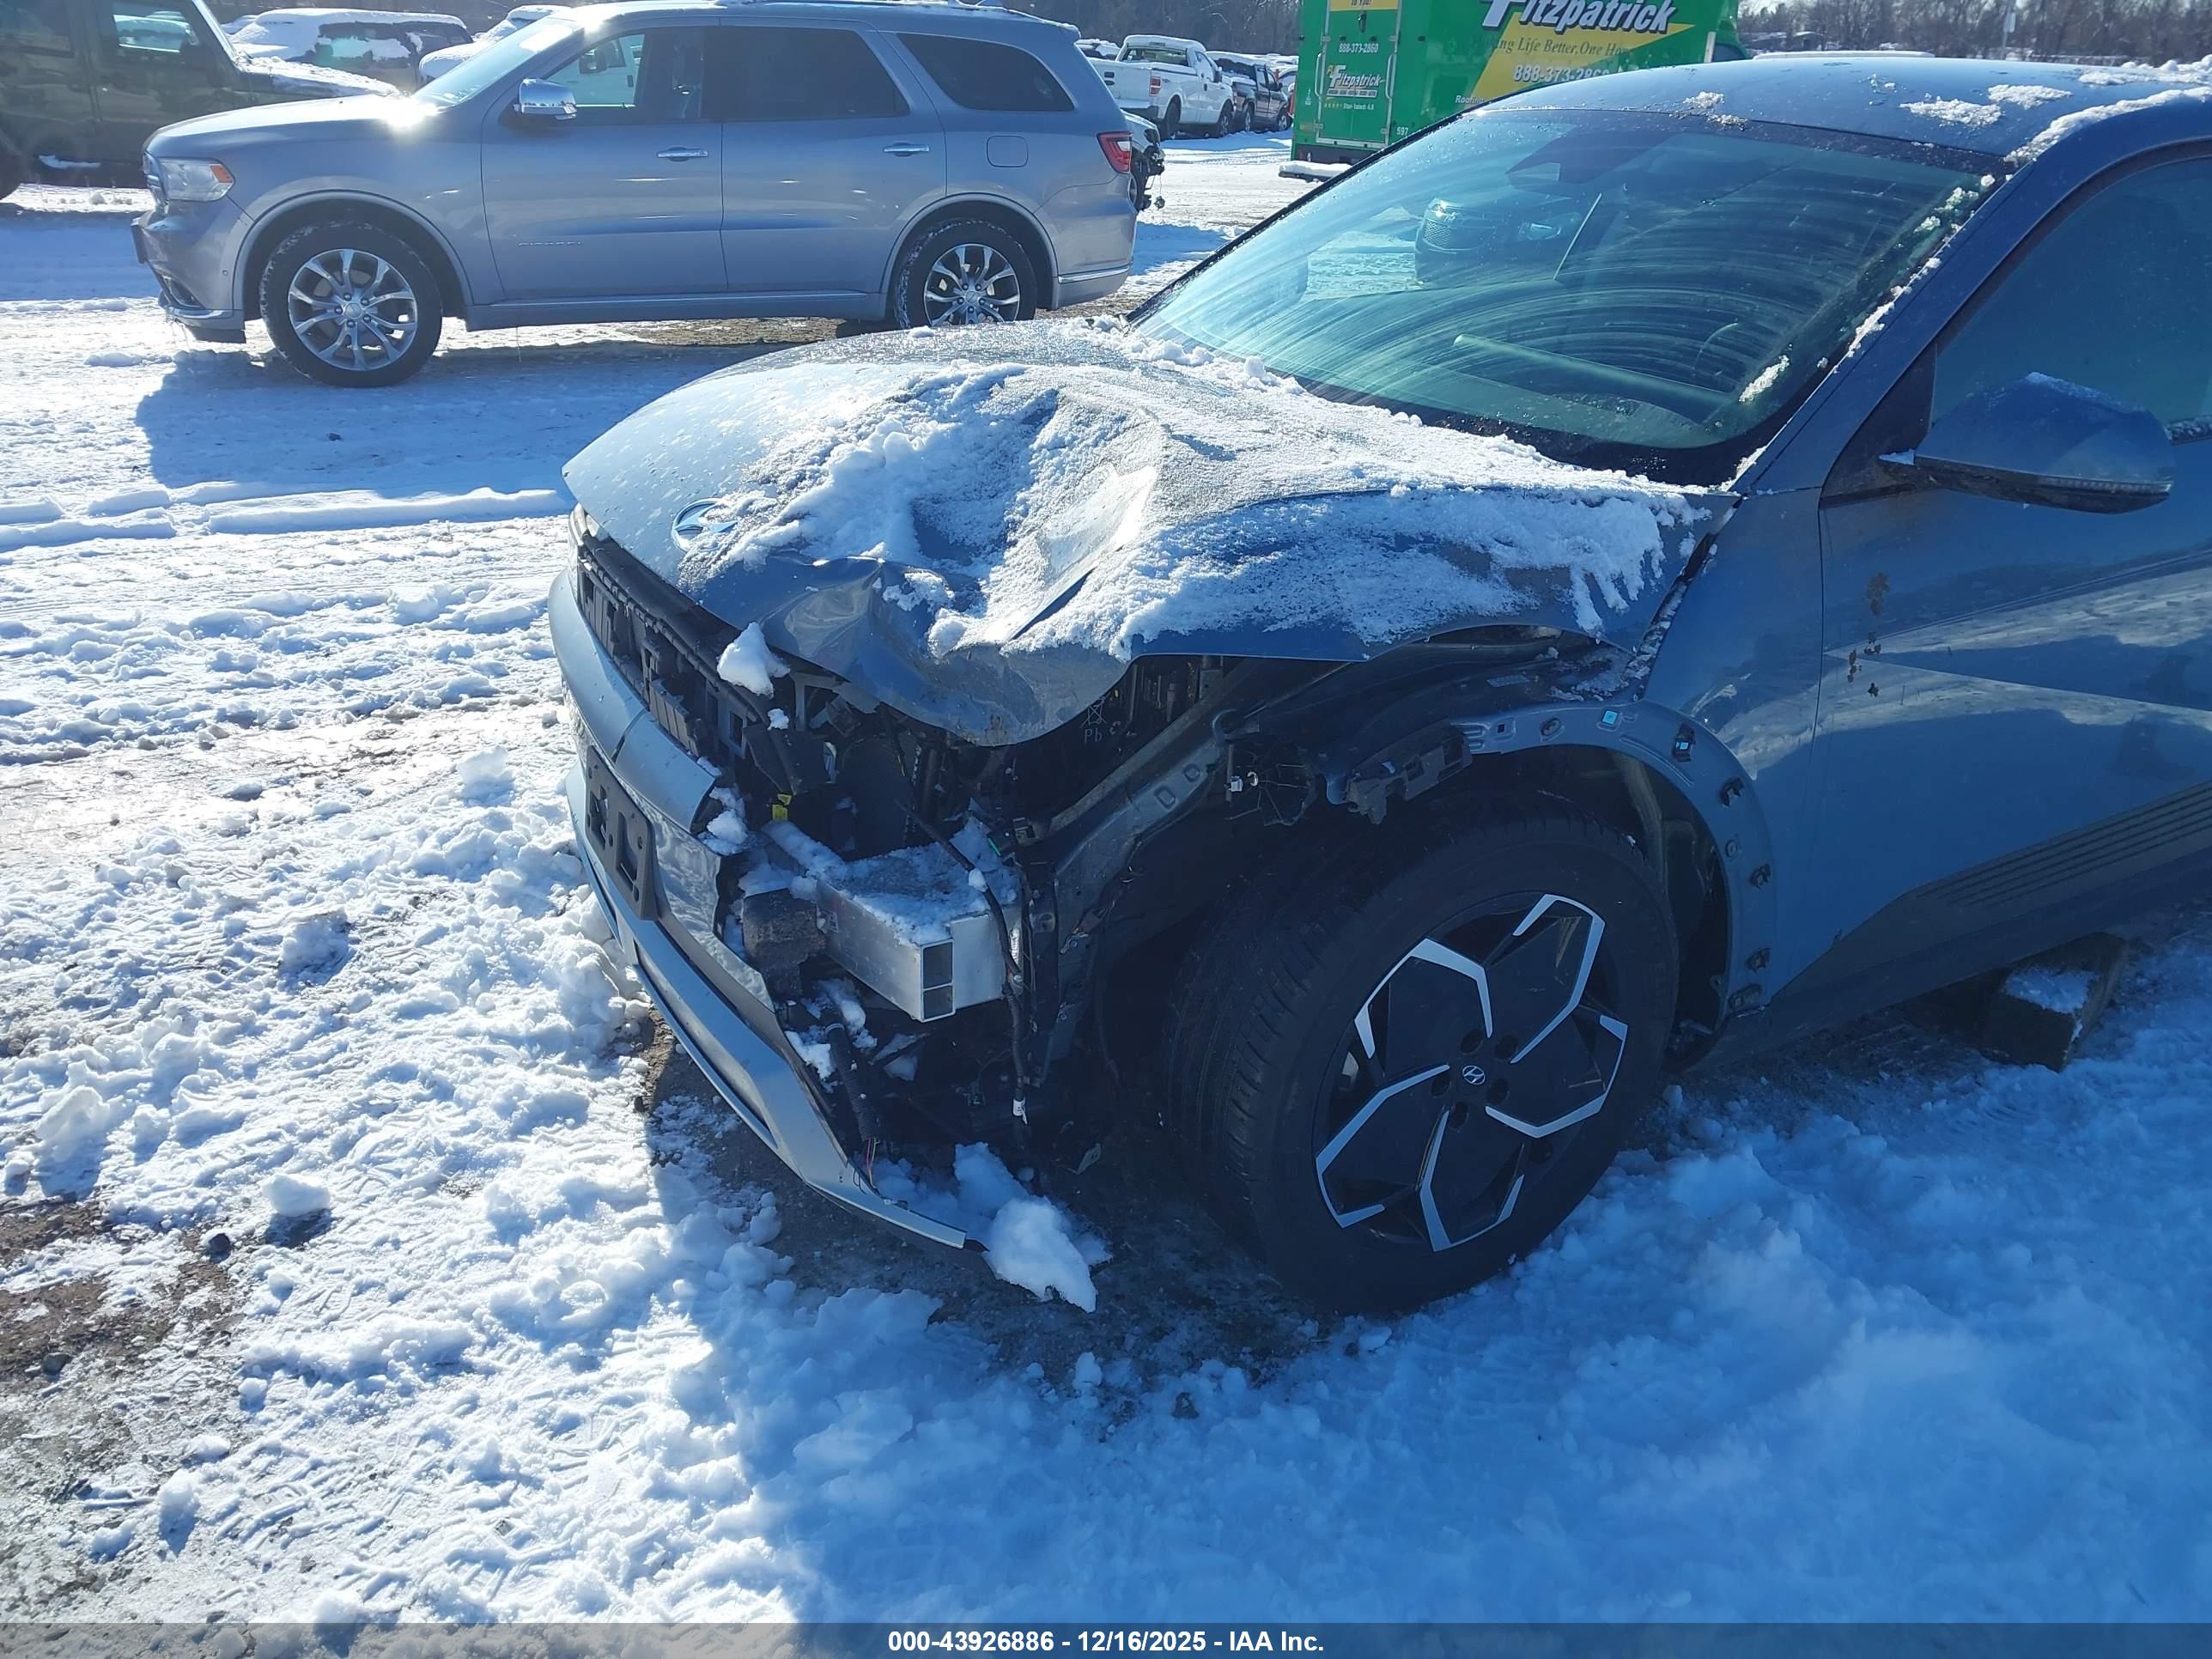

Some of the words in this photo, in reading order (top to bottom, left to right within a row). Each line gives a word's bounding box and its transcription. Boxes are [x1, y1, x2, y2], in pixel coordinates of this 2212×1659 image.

[1517, 37, 1540, 53] Life
[1329, 64, 1382, 88] Fitzpatrick
[1085, 728, 1103, 743] Pb
